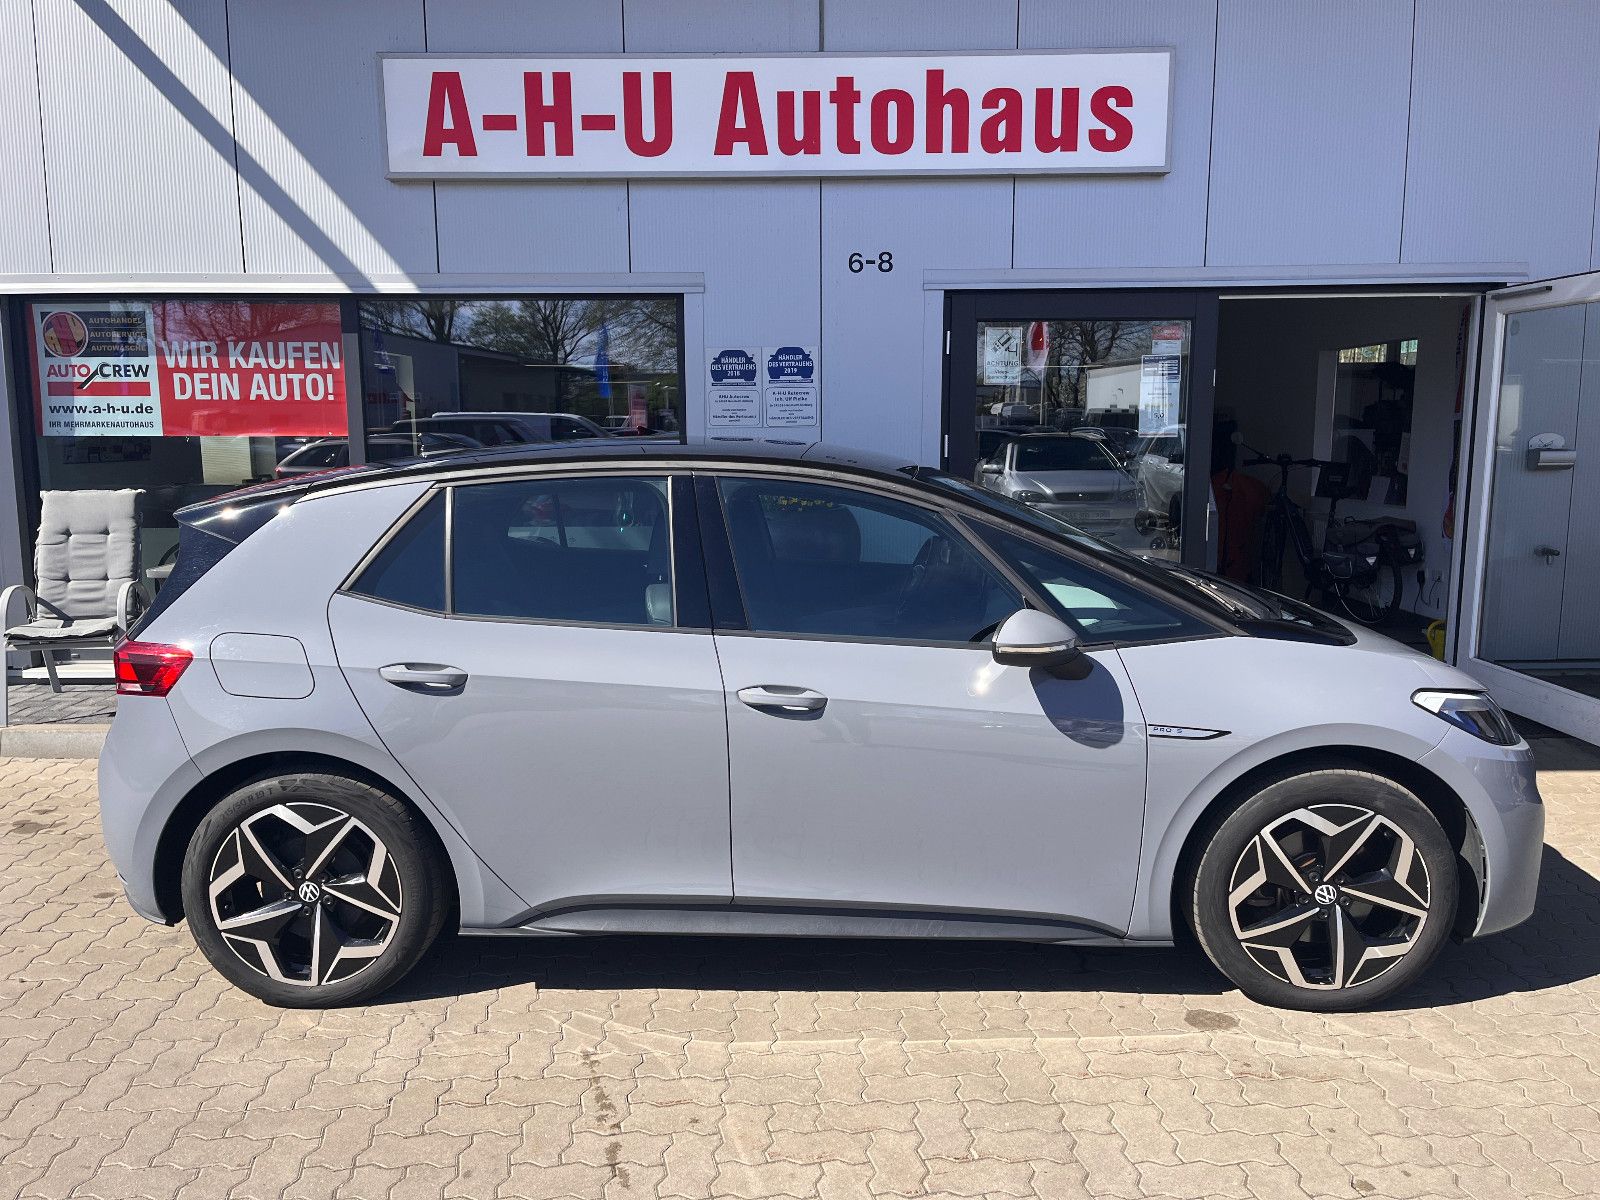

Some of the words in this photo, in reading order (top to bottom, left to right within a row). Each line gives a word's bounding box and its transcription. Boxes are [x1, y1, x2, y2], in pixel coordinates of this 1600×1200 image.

[424, 71, 673, 157] A-H-U
[715, 69, 1134, 156] Autohaus
[848, 251, 894, 274] 6-8
[161, 341, 219, 369] WIR
[228, 341, 341, 369] KAUFEN
[173, 373, 240, 400] DEIN
[249, 373, 335, 401] AUTO!
[48, 403, 154, 414] www.a-h-u.de
